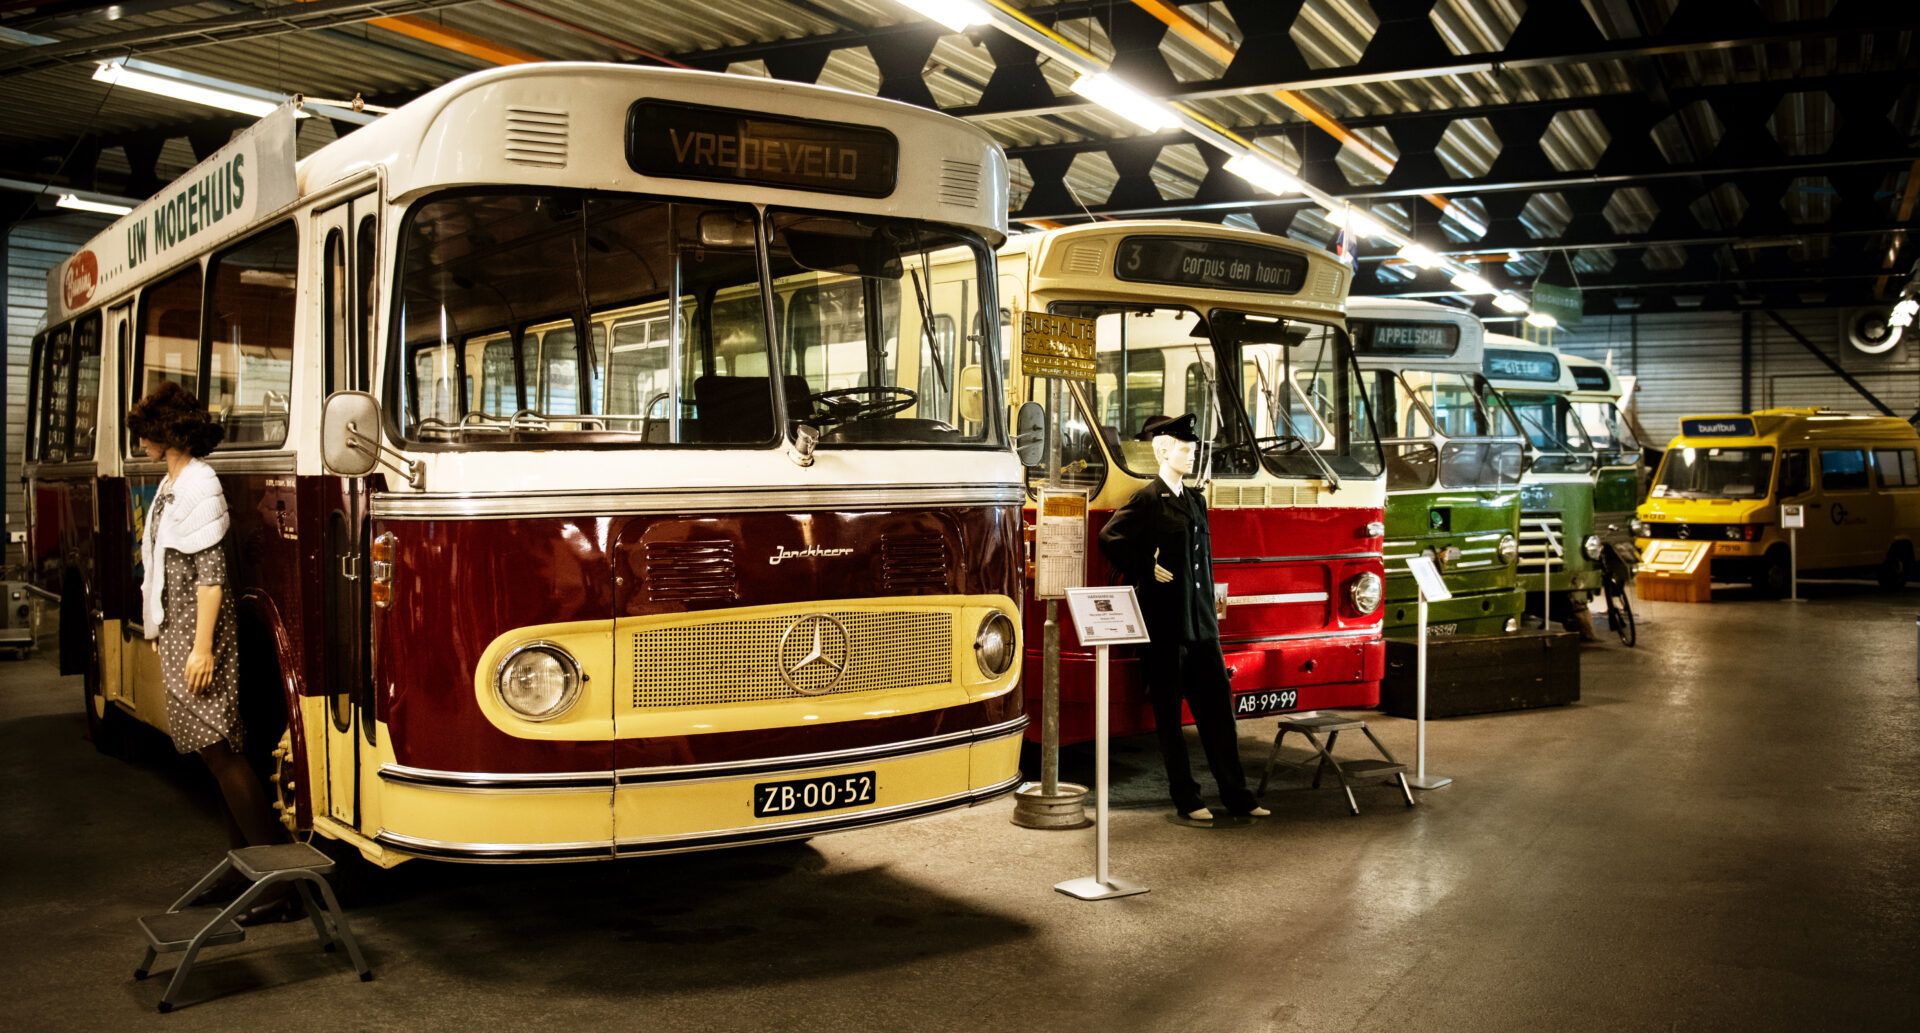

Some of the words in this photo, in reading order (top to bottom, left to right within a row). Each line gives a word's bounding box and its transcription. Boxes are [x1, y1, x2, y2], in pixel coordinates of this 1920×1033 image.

[669, 128, 858, 181] VREDEVELD
[128, 217, 147, 269] UW
[154, 153, 245, 255] MODEHUIS
[1127, 244, 1143, 271] 3
[1182, 255, 1225, 279] corpus
[1229, 259, 1250, 281] den
[1255, 262, 1292, 286] hoorn
[1025, 316, 1094, 341] BUSHALTE
[1378, 327, 1444, 346] APPELSCHA
[1698, 423, 1736, 433] buurtbus
[769, 544, 854, 565] Jonckheere
[1237, 690, 1297, 713] AB-99-99
[762, 776, 871, 813] ZB-00-52
